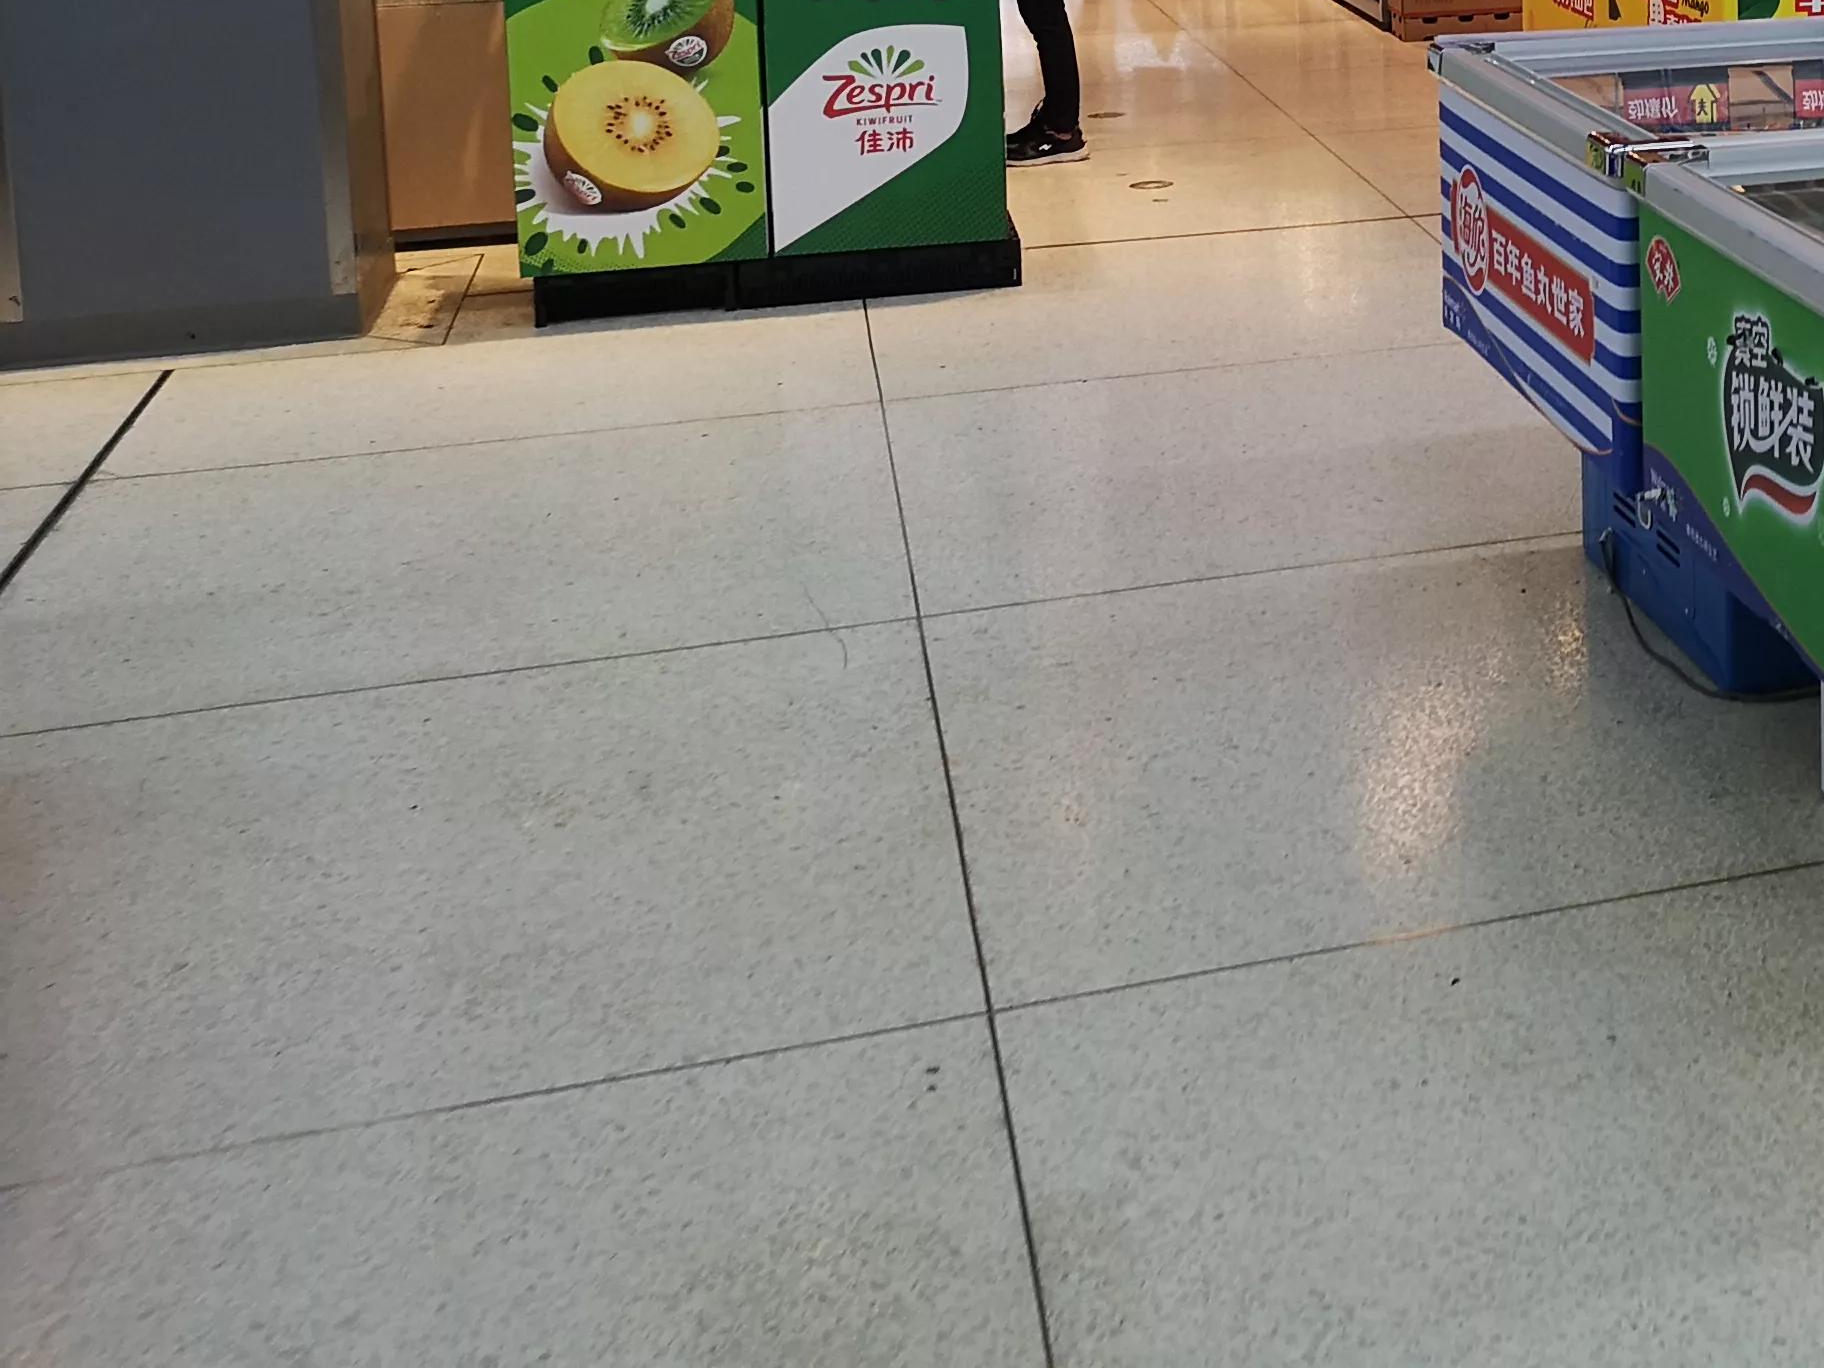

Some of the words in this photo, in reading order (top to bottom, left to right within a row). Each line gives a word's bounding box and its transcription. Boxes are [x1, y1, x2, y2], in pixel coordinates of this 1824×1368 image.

[822, 74, 936, 119] Zespri
[856, 115, 914, 127] KIWIFRUIT
[855, 131, 914, 155] 佳沛
[1491, 228, 1585, 338] 百年鱼丸世家
[1733, 316, 1768, 370] 真空
[1731, 373, 1817, 473] 锁鲜装
